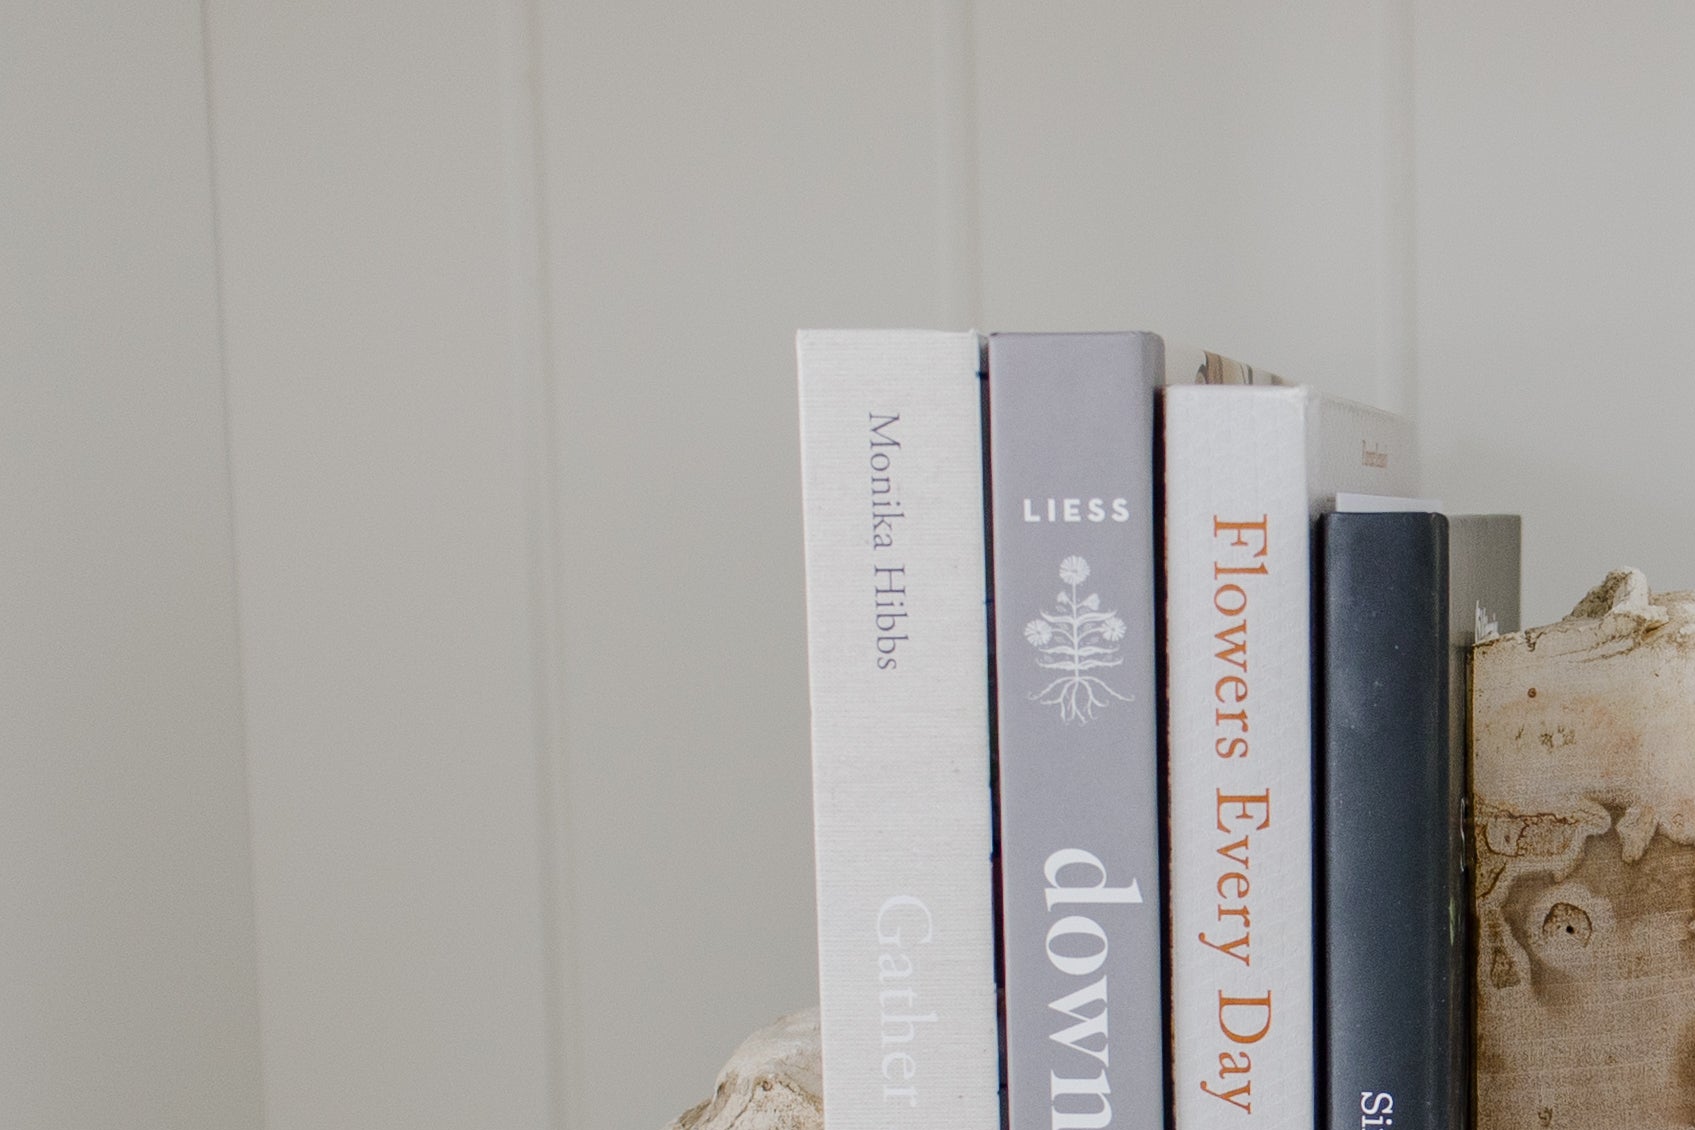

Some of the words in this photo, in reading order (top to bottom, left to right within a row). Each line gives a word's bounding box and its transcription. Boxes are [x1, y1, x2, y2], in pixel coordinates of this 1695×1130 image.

[868, 412, 906, 551] Monika
[1022, 498, 1131, 523] LIESS
[874, 564, 910, 671] Hibbs
[1212, 513, 1270, 759] Flowers
[1198, 787, 1271, 967] Every
[876, 894, 939, 1108] Gather
[1199, 989, 1273, 1115] Day
